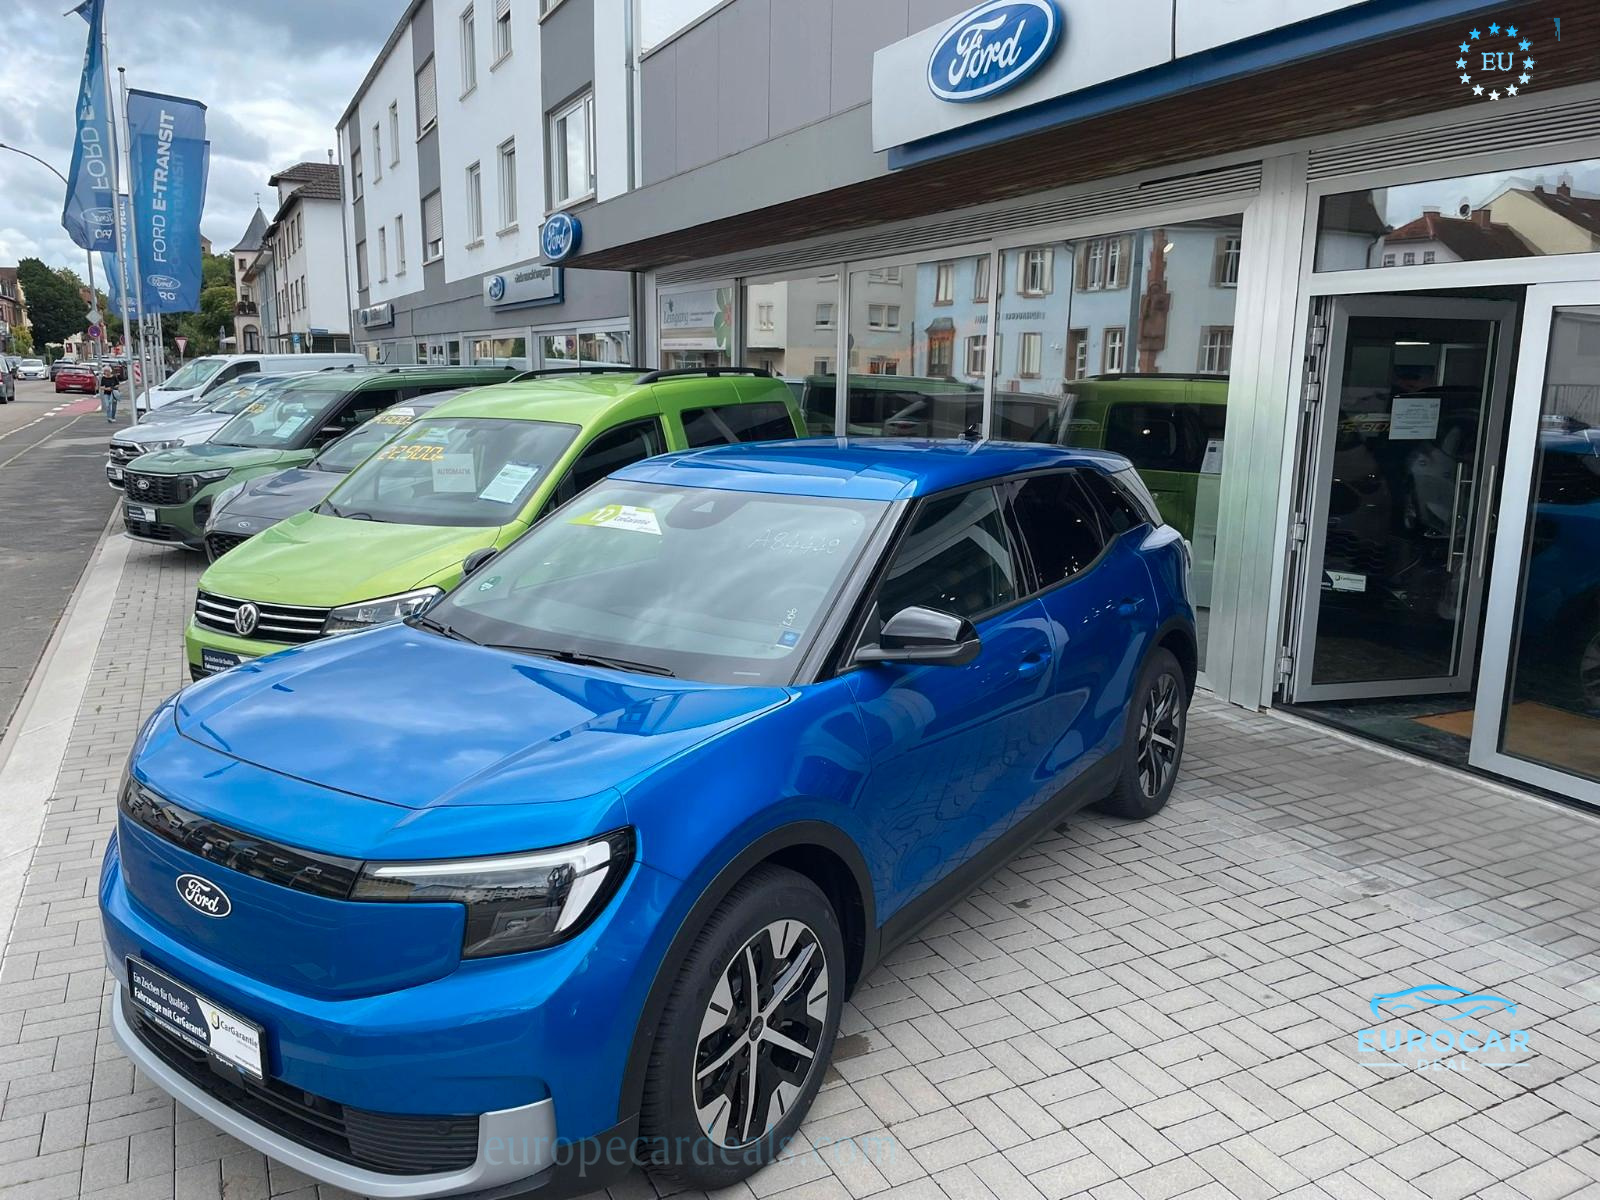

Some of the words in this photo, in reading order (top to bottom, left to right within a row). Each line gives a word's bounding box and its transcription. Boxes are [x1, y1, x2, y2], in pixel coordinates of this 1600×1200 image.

[948, 14, 1026, 86] Ford
[153, 110, 175, 211] E-TRANSIT
[153, 214, 167, 262] FORD
[547, 221, 566, 250] Ford
[185, 879, 219, 912] Ford
[133, 971, 142, 984] Ein
[142, 976, 160, 996] Zeichen
[160, 987, 168, 1001] für
[134, 987, 162, 1013] Fahrzeuge
[162, 1005, 172, 1019] mit
[173, 1012, 207, 1041] CarGarantie
[220, 1021, 258, 1049] CarGarantie
